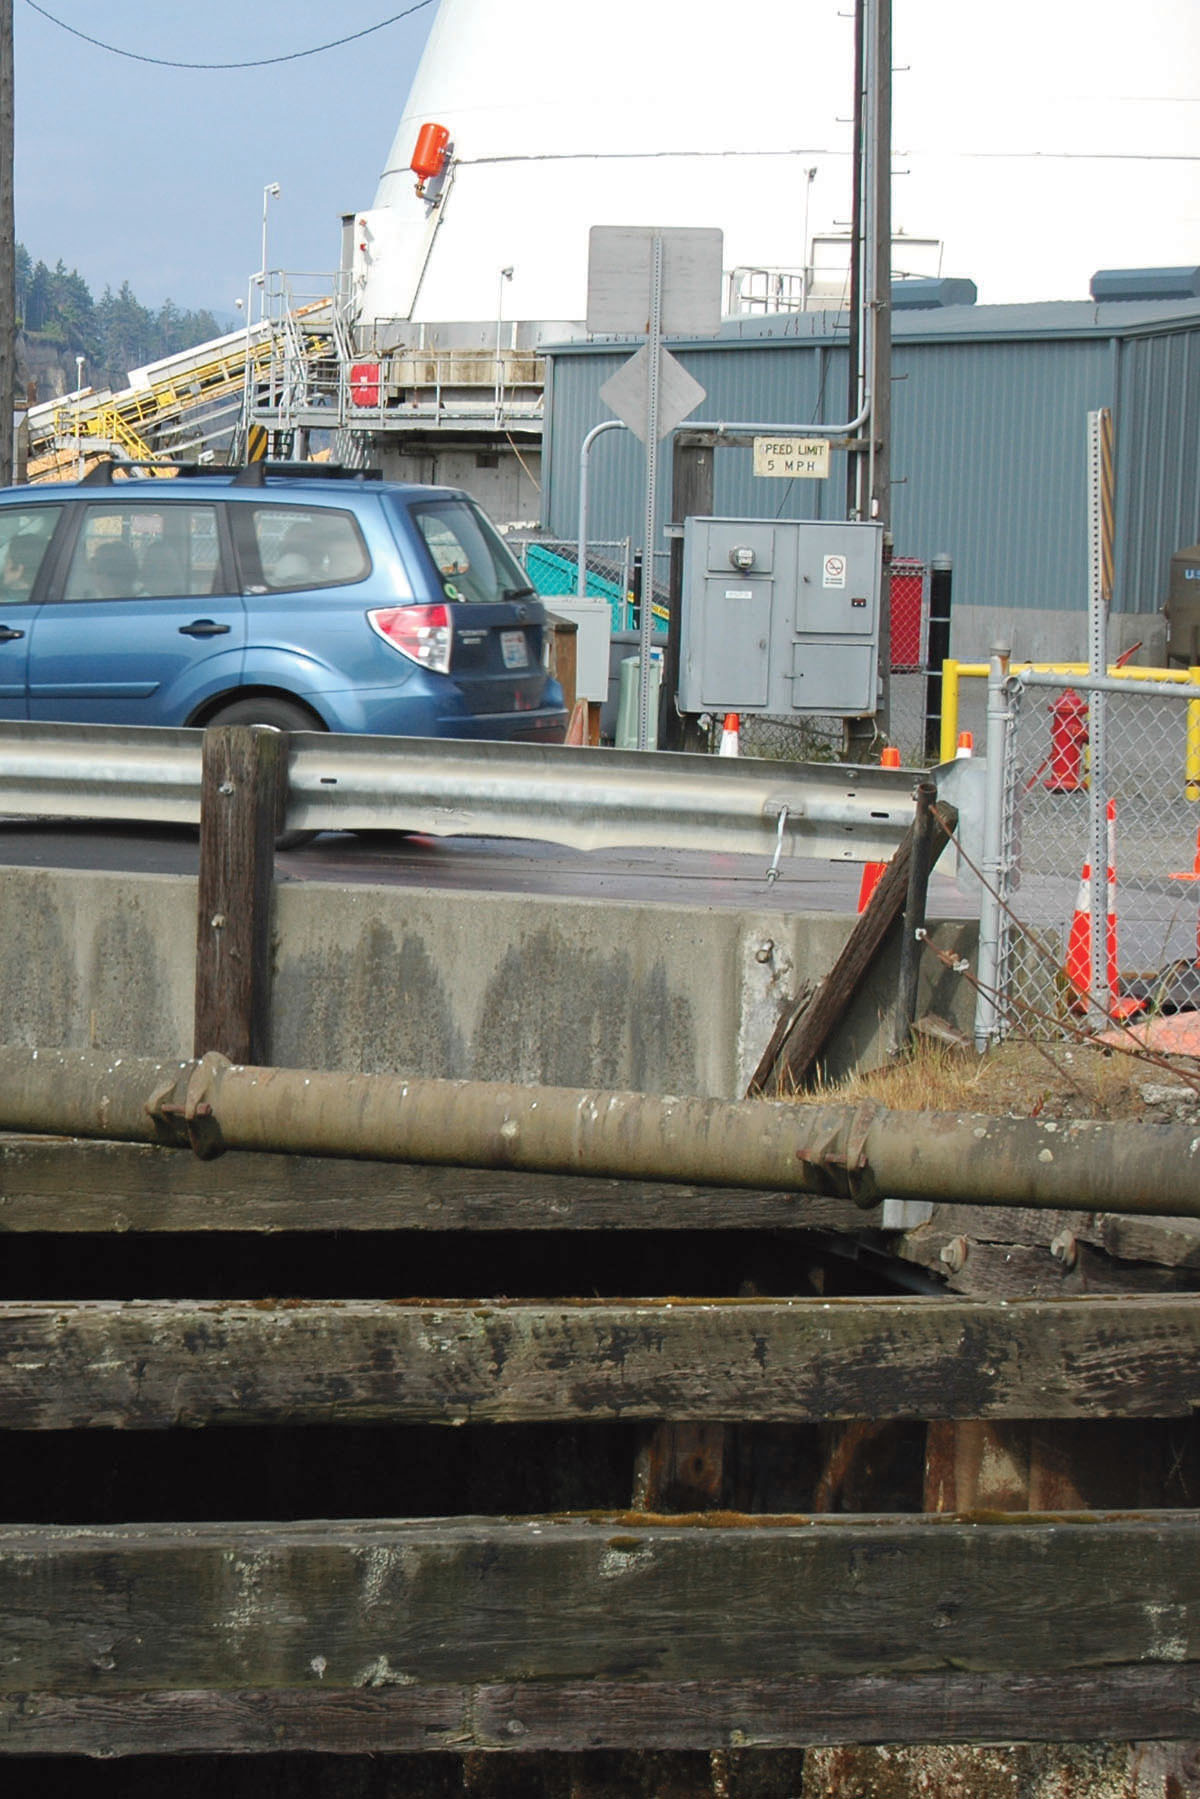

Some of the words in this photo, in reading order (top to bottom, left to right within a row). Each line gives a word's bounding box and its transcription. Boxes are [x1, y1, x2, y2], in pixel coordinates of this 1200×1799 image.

[798, 445, 825, 456] LIMIT
[767, 460, 775, 471] 5
[784, 460, 815, 472] MPH
